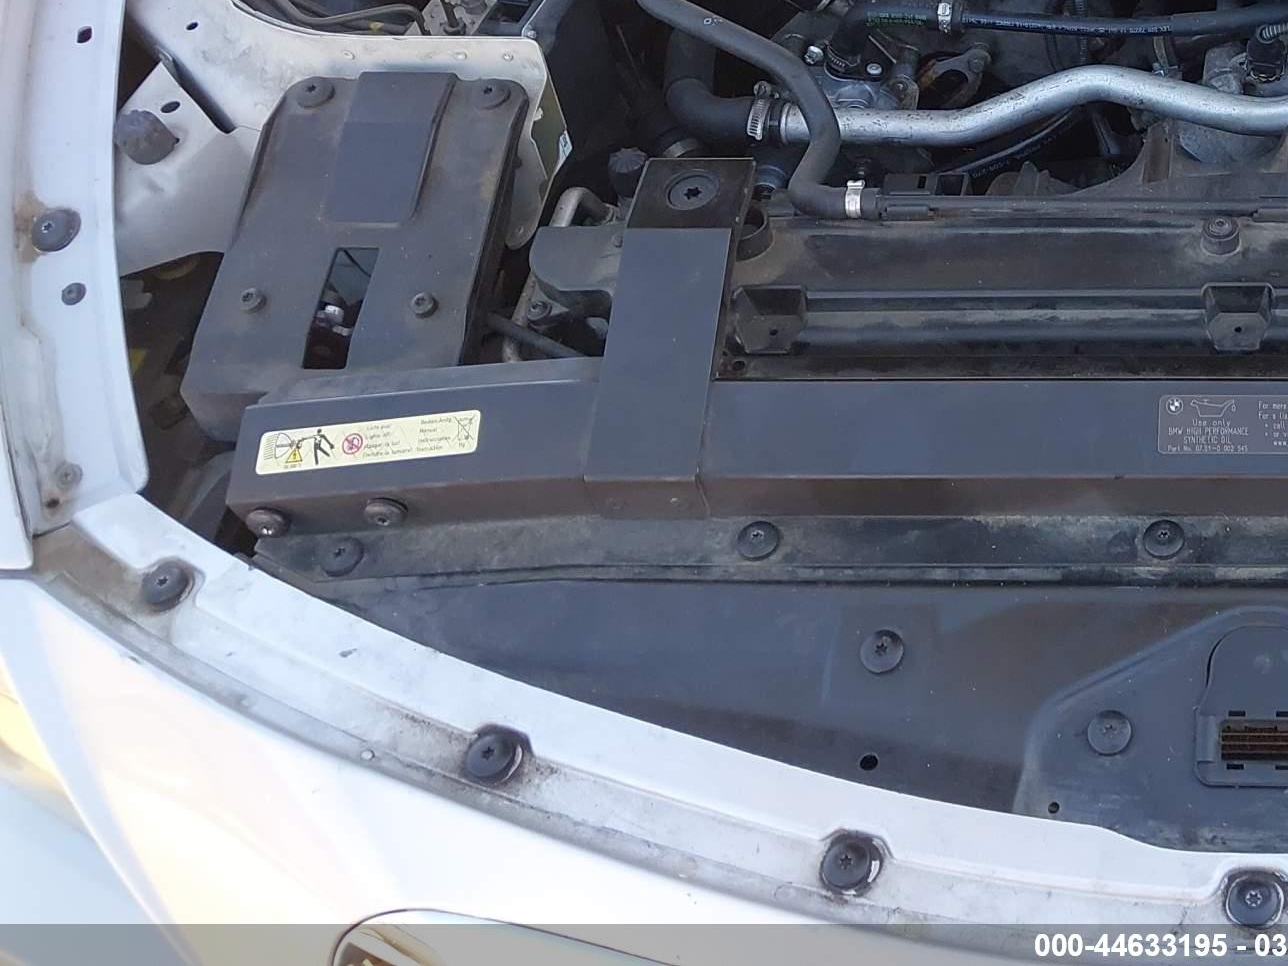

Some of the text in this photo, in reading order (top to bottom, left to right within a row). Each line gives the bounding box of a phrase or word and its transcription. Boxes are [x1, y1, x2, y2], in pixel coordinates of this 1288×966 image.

[1212, 418, 1231, 427] only
[1168, 427, 1249, 435] BMW HIGH PERFORMANCE
[1183, 436, 1231, 444] SYNTHETIC OIL
